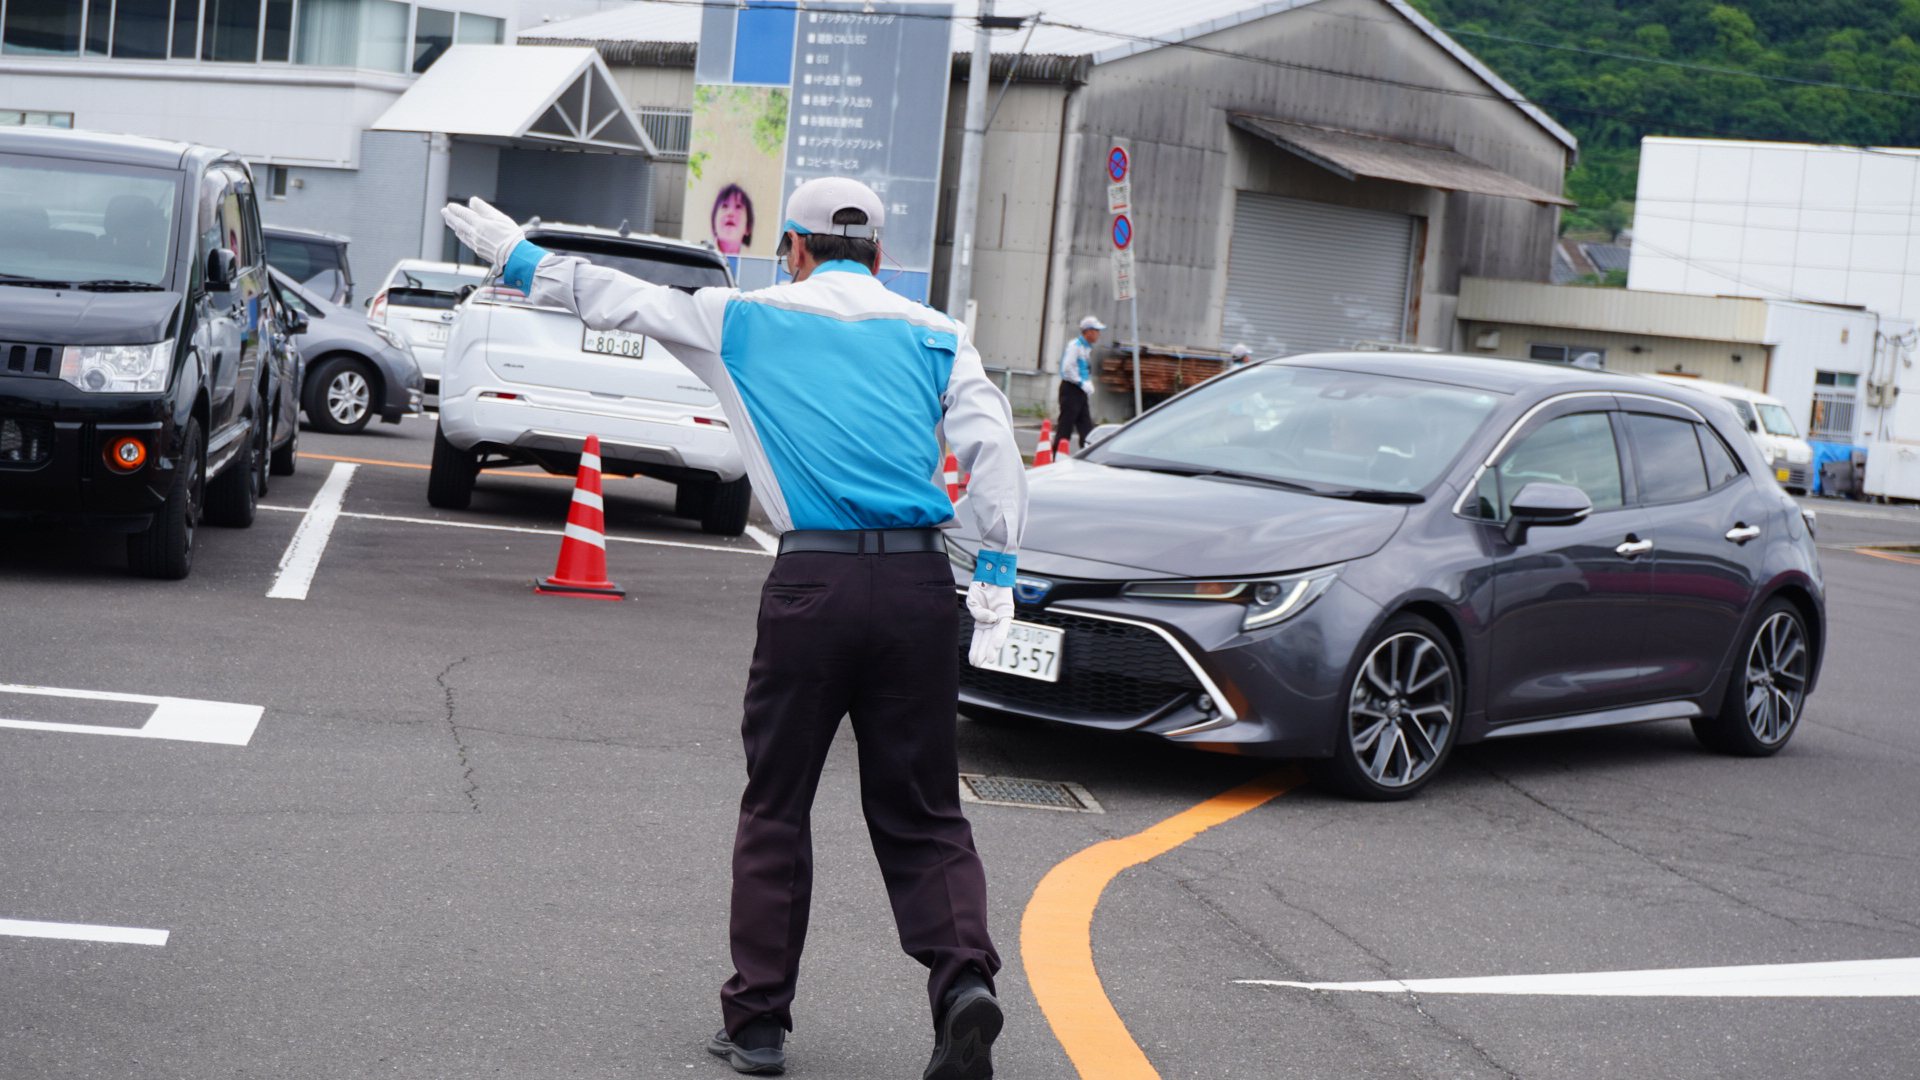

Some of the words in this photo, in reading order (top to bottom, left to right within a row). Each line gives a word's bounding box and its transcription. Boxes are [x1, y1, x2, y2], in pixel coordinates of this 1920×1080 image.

[811, 96, 873, 108] 各種データ入出力
[808, 138, 883, 150] オンデマンドプリント
[806, 158, 859, 169] コピーサービス
[596, 336, 640, 356] 80-08
